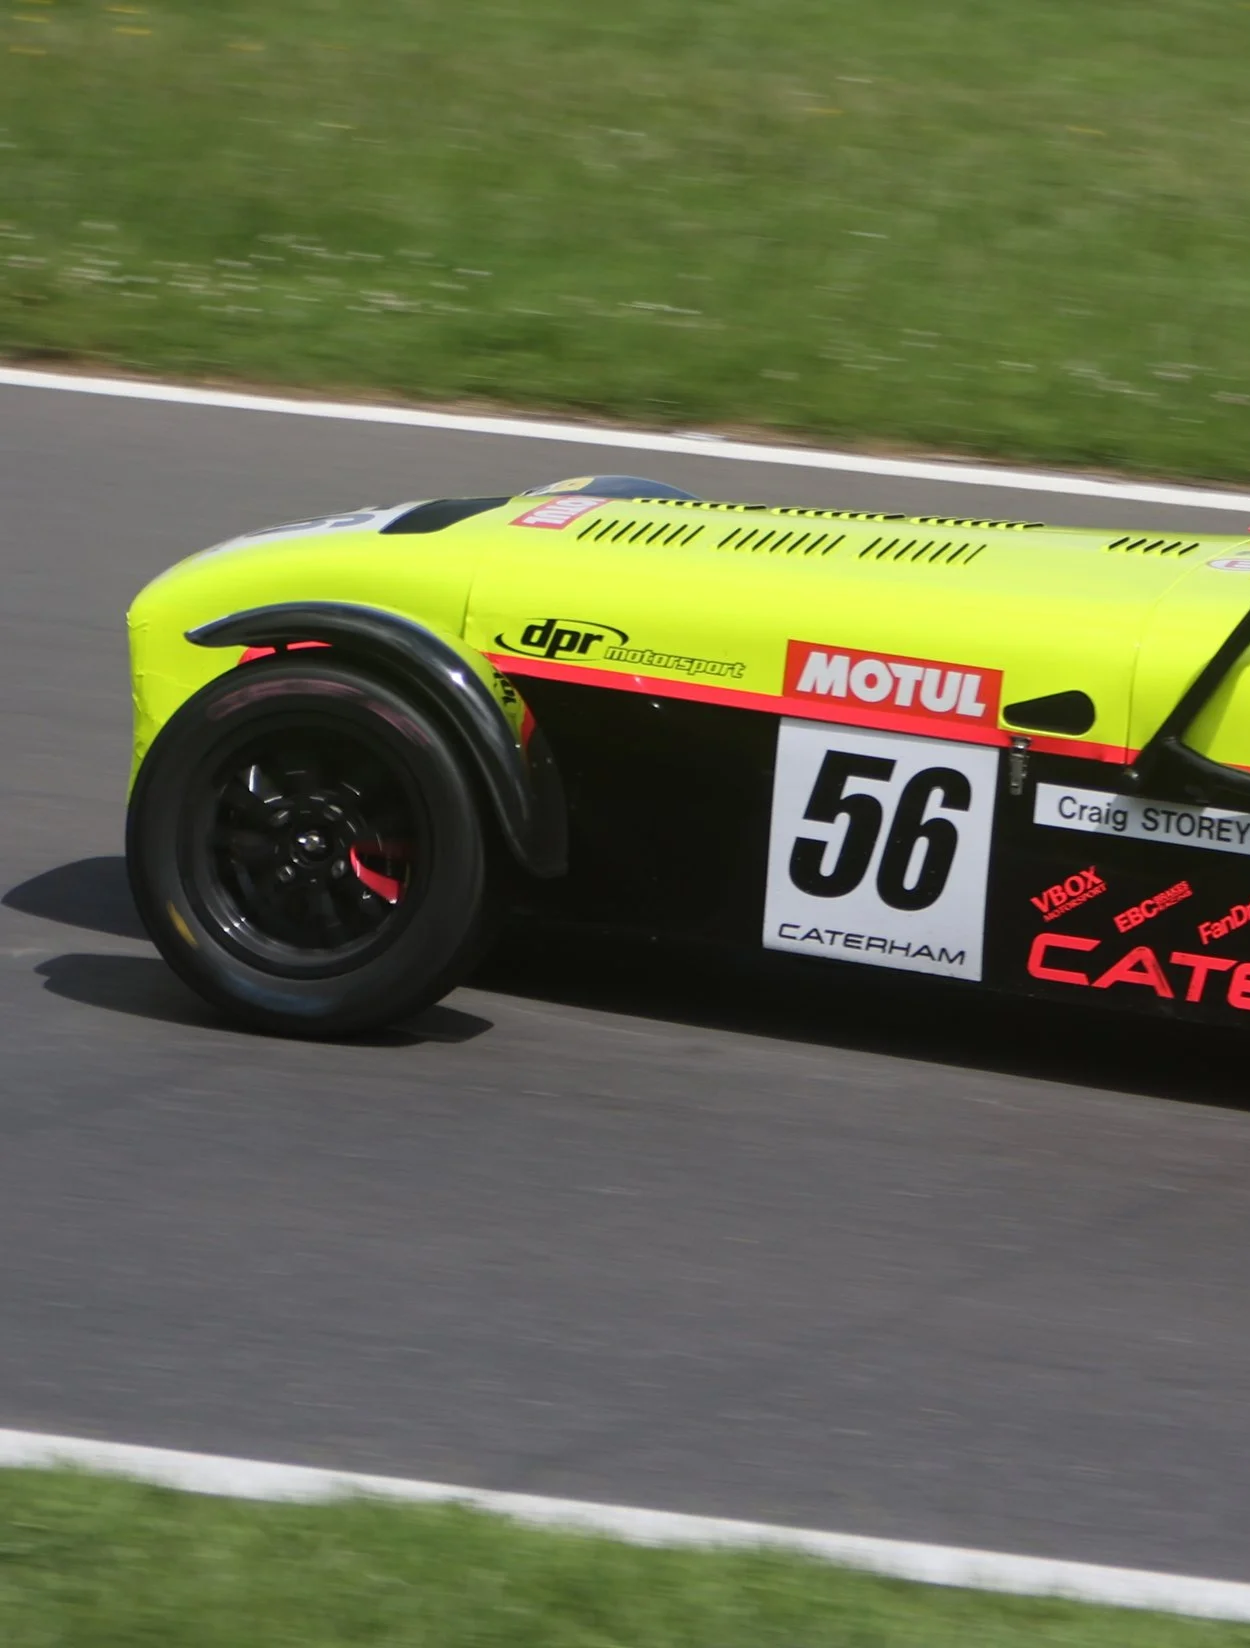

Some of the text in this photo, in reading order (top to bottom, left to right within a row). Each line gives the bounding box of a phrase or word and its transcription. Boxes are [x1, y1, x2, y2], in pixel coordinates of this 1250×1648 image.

[520, 619, 604, 658] dpr
[604, 646, 746, 678] motorsport
[796, 651, 986, 718] MOTUL
[788, 750, 973, 912] 56
[1058, 796, 1128, 832] Craig
[1030, 865, 1103, 913] VBOX
[1043, 882, 1107, 922] MOTORSPORT
[1113, 899, 1160, 933] EBC
[777, 923, 966, 966] CATERHAM
